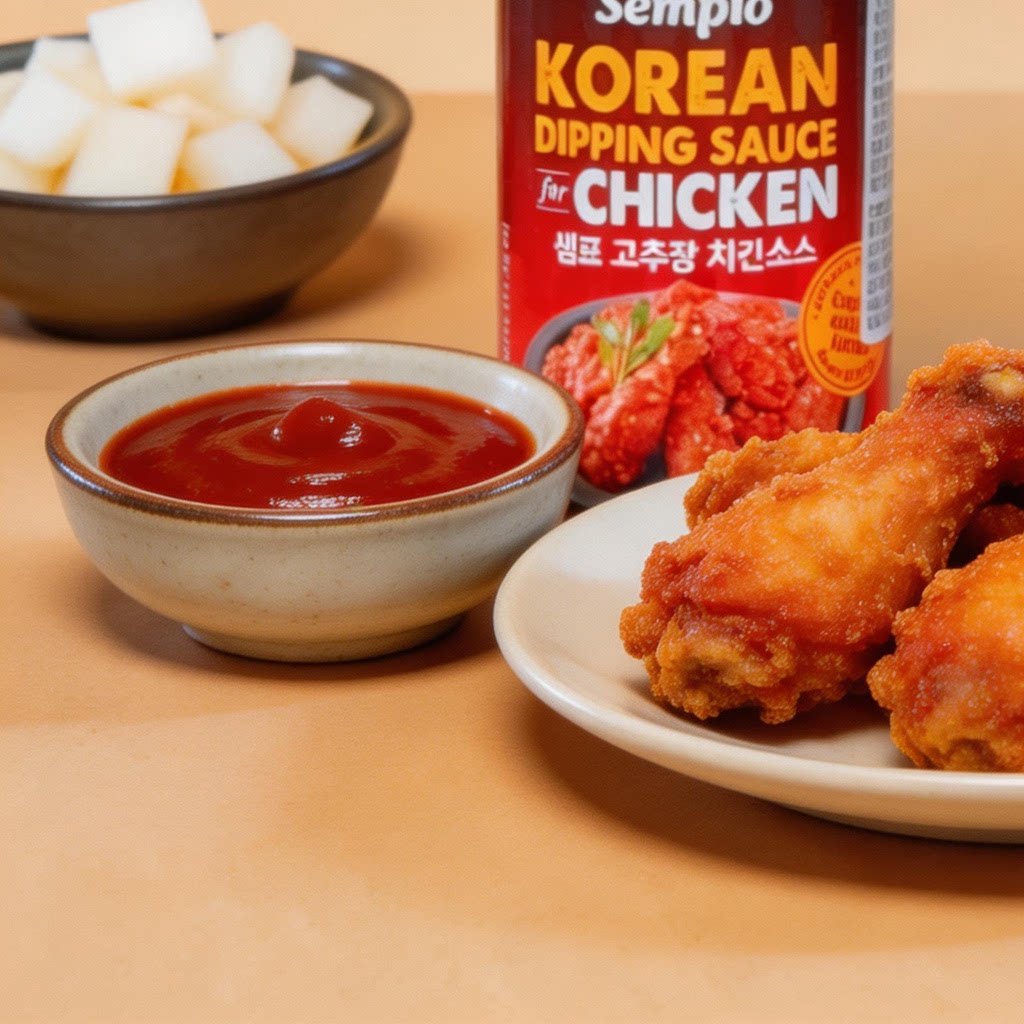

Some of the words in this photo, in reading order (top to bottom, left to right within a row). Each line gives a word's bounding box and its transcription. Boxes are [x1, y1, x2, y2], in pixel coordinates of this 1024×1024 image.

[535, 39, 838, 117] KOREAN
[534, 115, 698, 165] DIPPING
[709, 118, 838, 166] SAUCE
[537, 175, 569, 204] for
[573, 164, 838, 231] CHICKEN
[609, 238, 699, 274] 고추장
